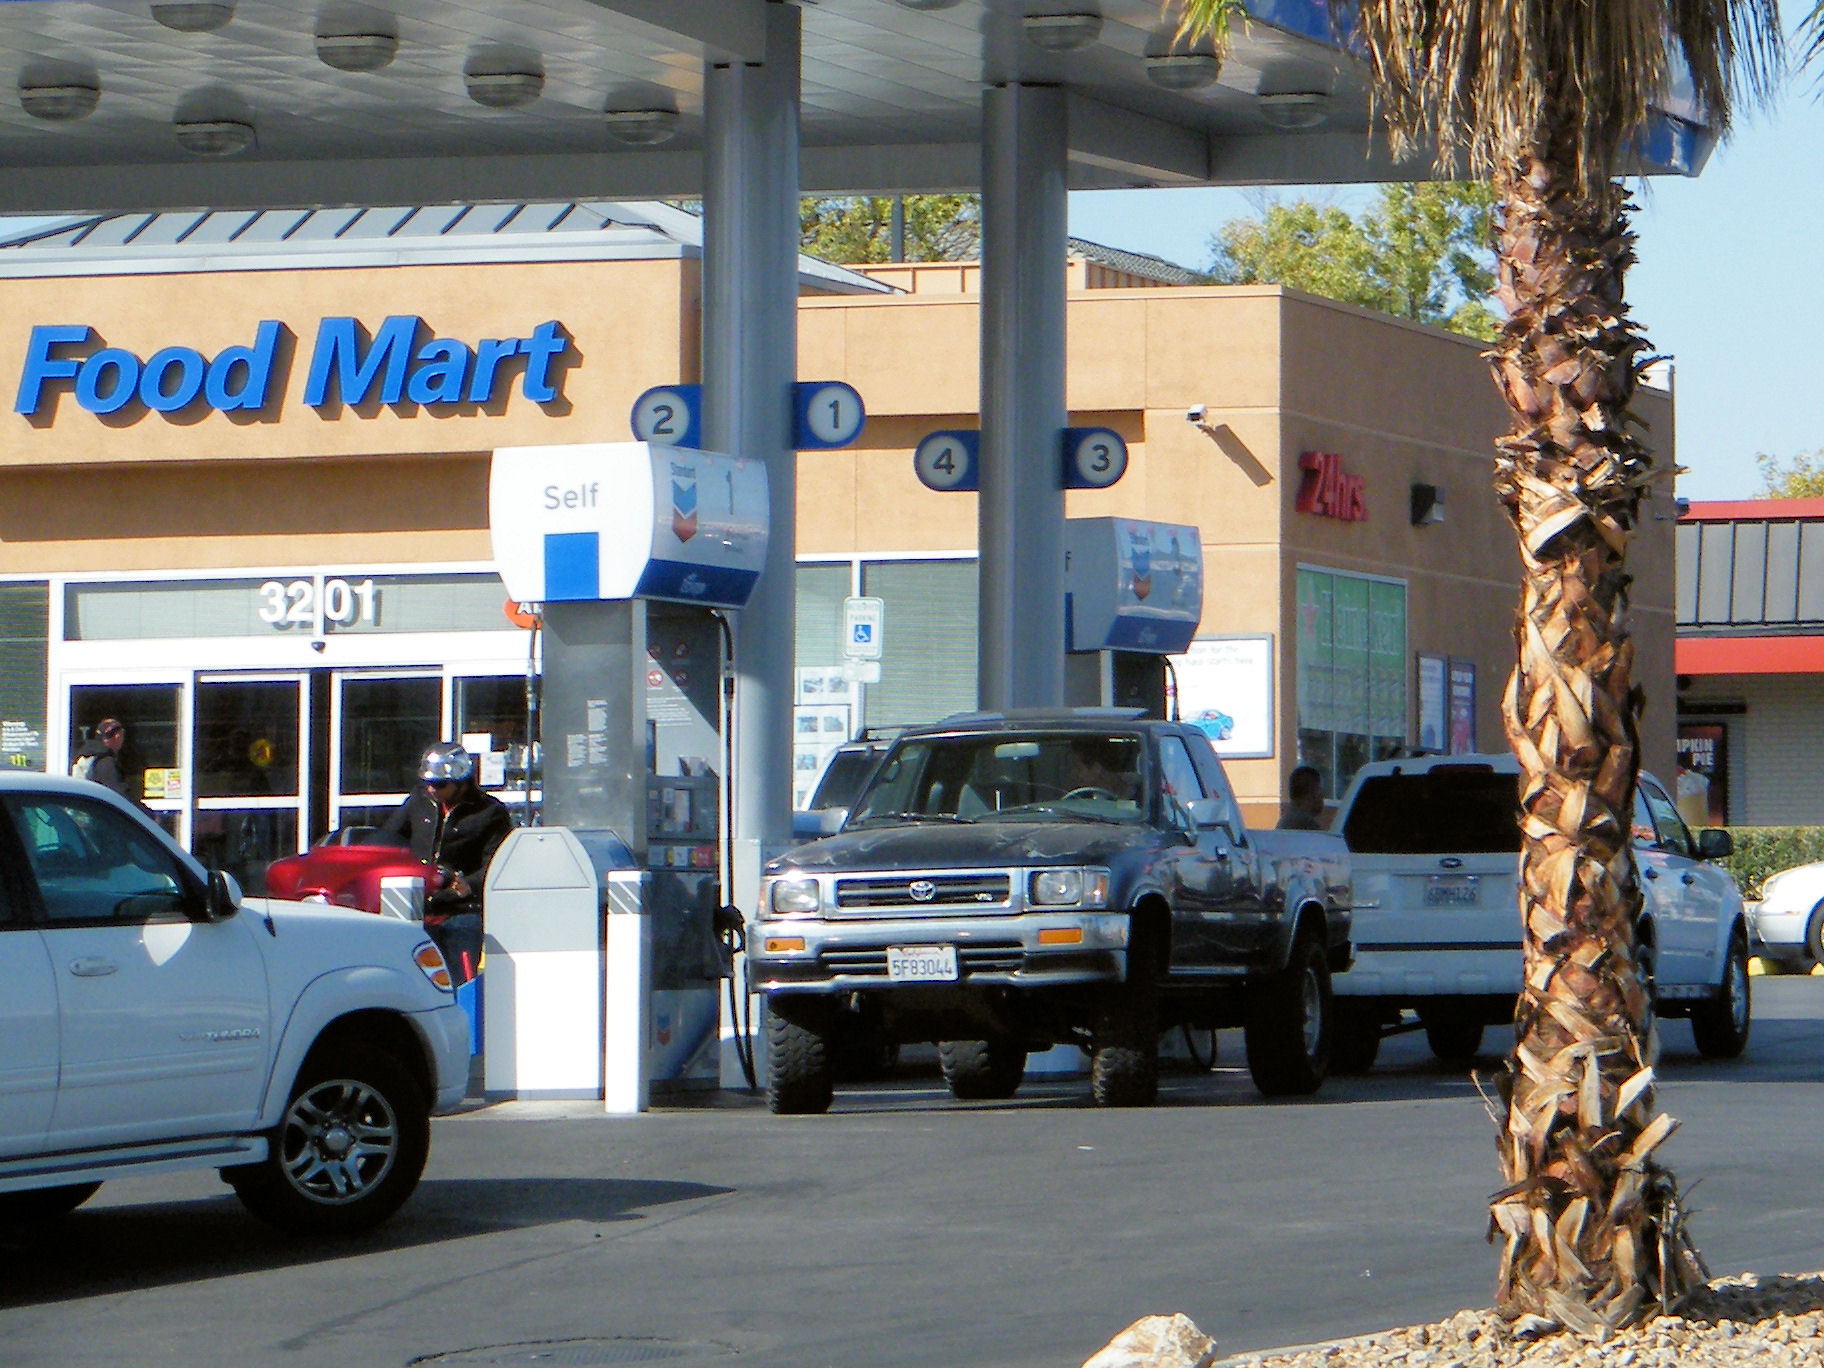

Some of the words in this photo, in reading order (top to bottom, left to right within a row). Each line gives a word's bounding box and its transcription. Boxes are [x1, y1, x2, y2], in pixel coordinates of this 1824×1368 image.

[14, 320, 286, 415] Food
[303, 314, 567, 405] Mart
[652, 405, 675, 435] 2
[828, 399, 840, 430] 1
[932, 447, 956, 475] 4
[1090, 444, 1111, 472] 3
[543, 482, 599, 510] Self
[258, 578, 375, 623] 3201
[1692, 752, 1715, 767] PIE
[892, 958, 953, 976] 5F83044
